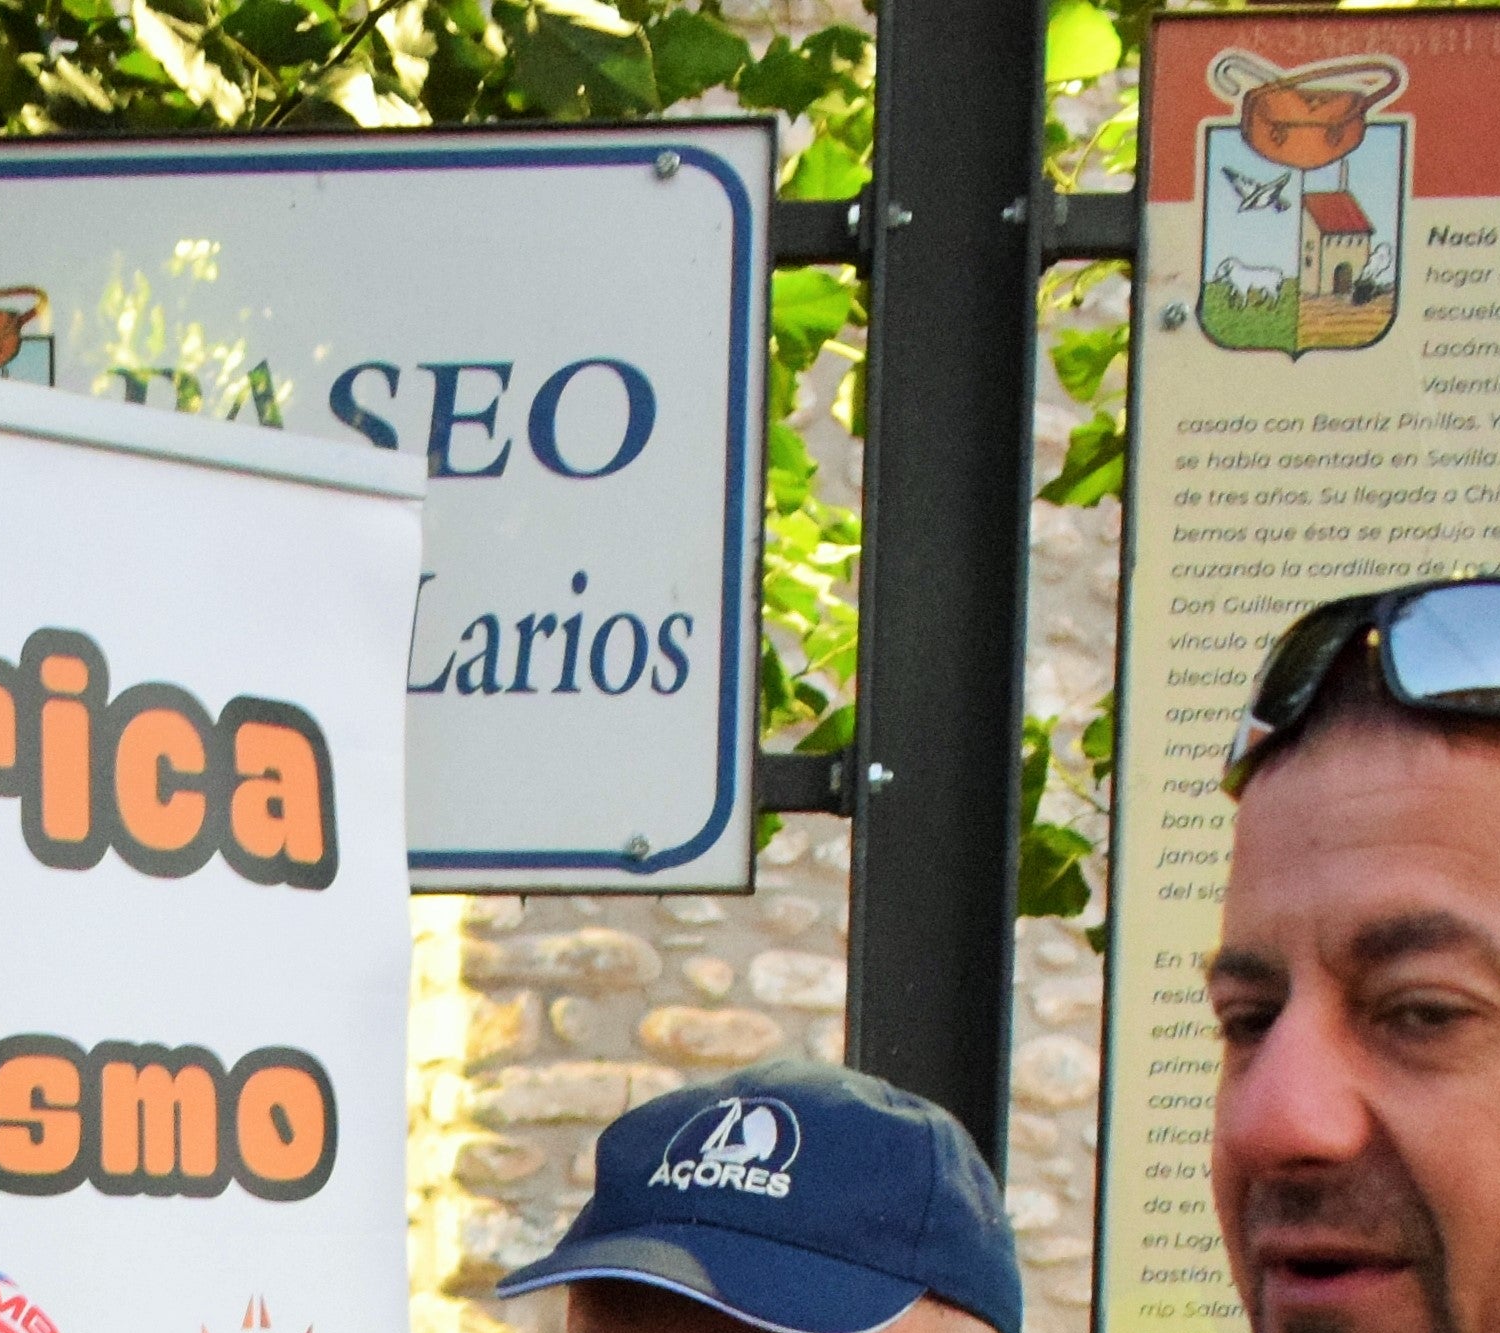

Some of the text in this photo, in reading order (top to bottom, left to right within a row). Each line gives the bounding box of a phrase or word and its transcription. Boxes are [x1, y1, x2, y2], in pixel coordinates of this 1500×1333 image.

[1427, 227, 1499, 246] Nació
[1425, 263, 1493, 287] hogar
[1177, 413, 1259, 432] casado
[1264, 418, 1305, 432] con
[1312, 412, 1391, 431] Beatriz
[1173, 523, 1249, 542] bemos
[1254, 528, 1298, 547] que
[1303, 522, 1351, 541] ésta
[1388, 521, 1476, 546] produjo
[404, 570, 695, 696] Larios
[1166, 667, 1248, 687] blecido
[647, 1160, 792, 1198] AÇORES
